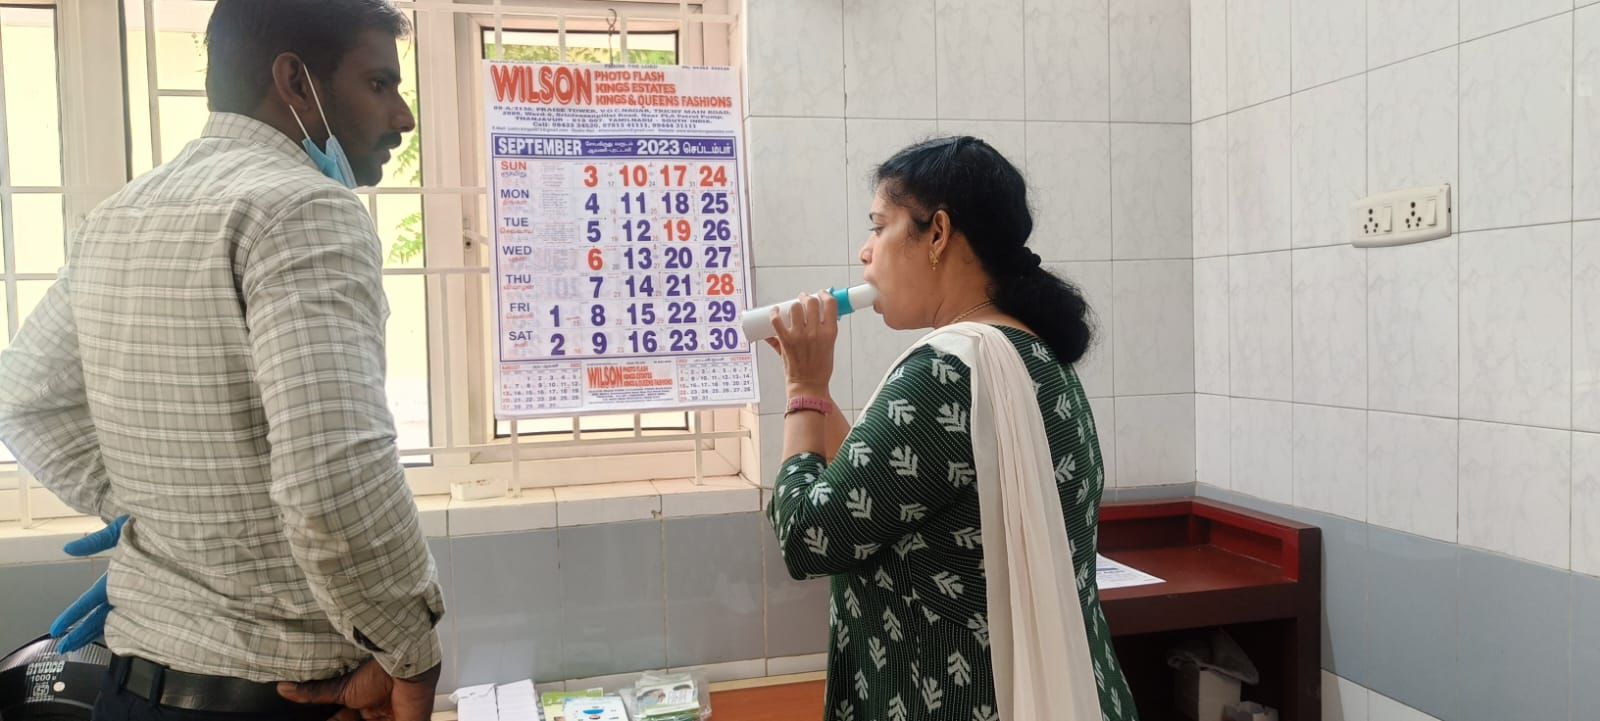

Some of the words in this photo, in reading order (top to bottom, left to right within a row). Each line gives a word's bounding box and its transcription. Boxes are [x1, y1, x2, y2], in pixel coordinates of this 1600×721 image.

[490, 64, 592, 106] WILSON
[594, 70, 631, 81] PHOTO
[633, 72, 664, 82] FLASH
[595, 82, 630, 94] KINGS
[632, 83, 676, 94] ESTATES
[595, 94, 627, 105] KINGS
[628, 96, 637, 106] &
[639, 96, 679, 107] QUEENS
[682, 96, 732, 108] FASHIONS
[498, 137, 582, 155] SEPTEMBER
[636, 140, 680, 154] 2023
[500, 161, 527, 170] SUN
[584, 165, 598, 188] 3
[619, 165, 648, 187] 10
[660, 164, 687, 187] 17
[699, 165, 727, 187] 24
[500, 189, 529, 198] MON
[584, 193, 600, 214] 4
[621, 192, 646, 214] 11
[662, 192, 689, 214] 18
[701, 192, 729, 214] 25
[504, 217, 529, 227] TUE
[586, 221, 601, 243] 5
[622, 220, 651, 241] 12
[663, 219, 691, 241] 19
[702, 219, 731, 241] 26
[502, 246, 532, 255] WED
[587, 248, 603, 270] 6
[624, 247, 652, 269] 13
[664, 247, 692, 269] 20
[704, 247, 732, 268] 27
[506, 274, 531, 284] THU
[589, 276, 603, 298] 7
[625, 275, 654, 297] 14
[666, 274, 691, 296] 21
[706, 273, 735, 295] 28
[510, 303, 530, 312] FRI
[549, 305, 560, 327] 1
[591, 304, 606, 326] 8
[627, 303, 655, 325] 15
[668, 302, 697, 324] 22
[708, 301, 736, 322] 29
[508, 331, 533, 340] SAT
[550, 333, 566, 355] 2
[592, 332, 607, 354] 9
[628, 330, 657, 353] 16
[670, 329, 698, 351] 23
[709, 328, 738, 350] 30
[587, 366, 623, 388] WILSON
